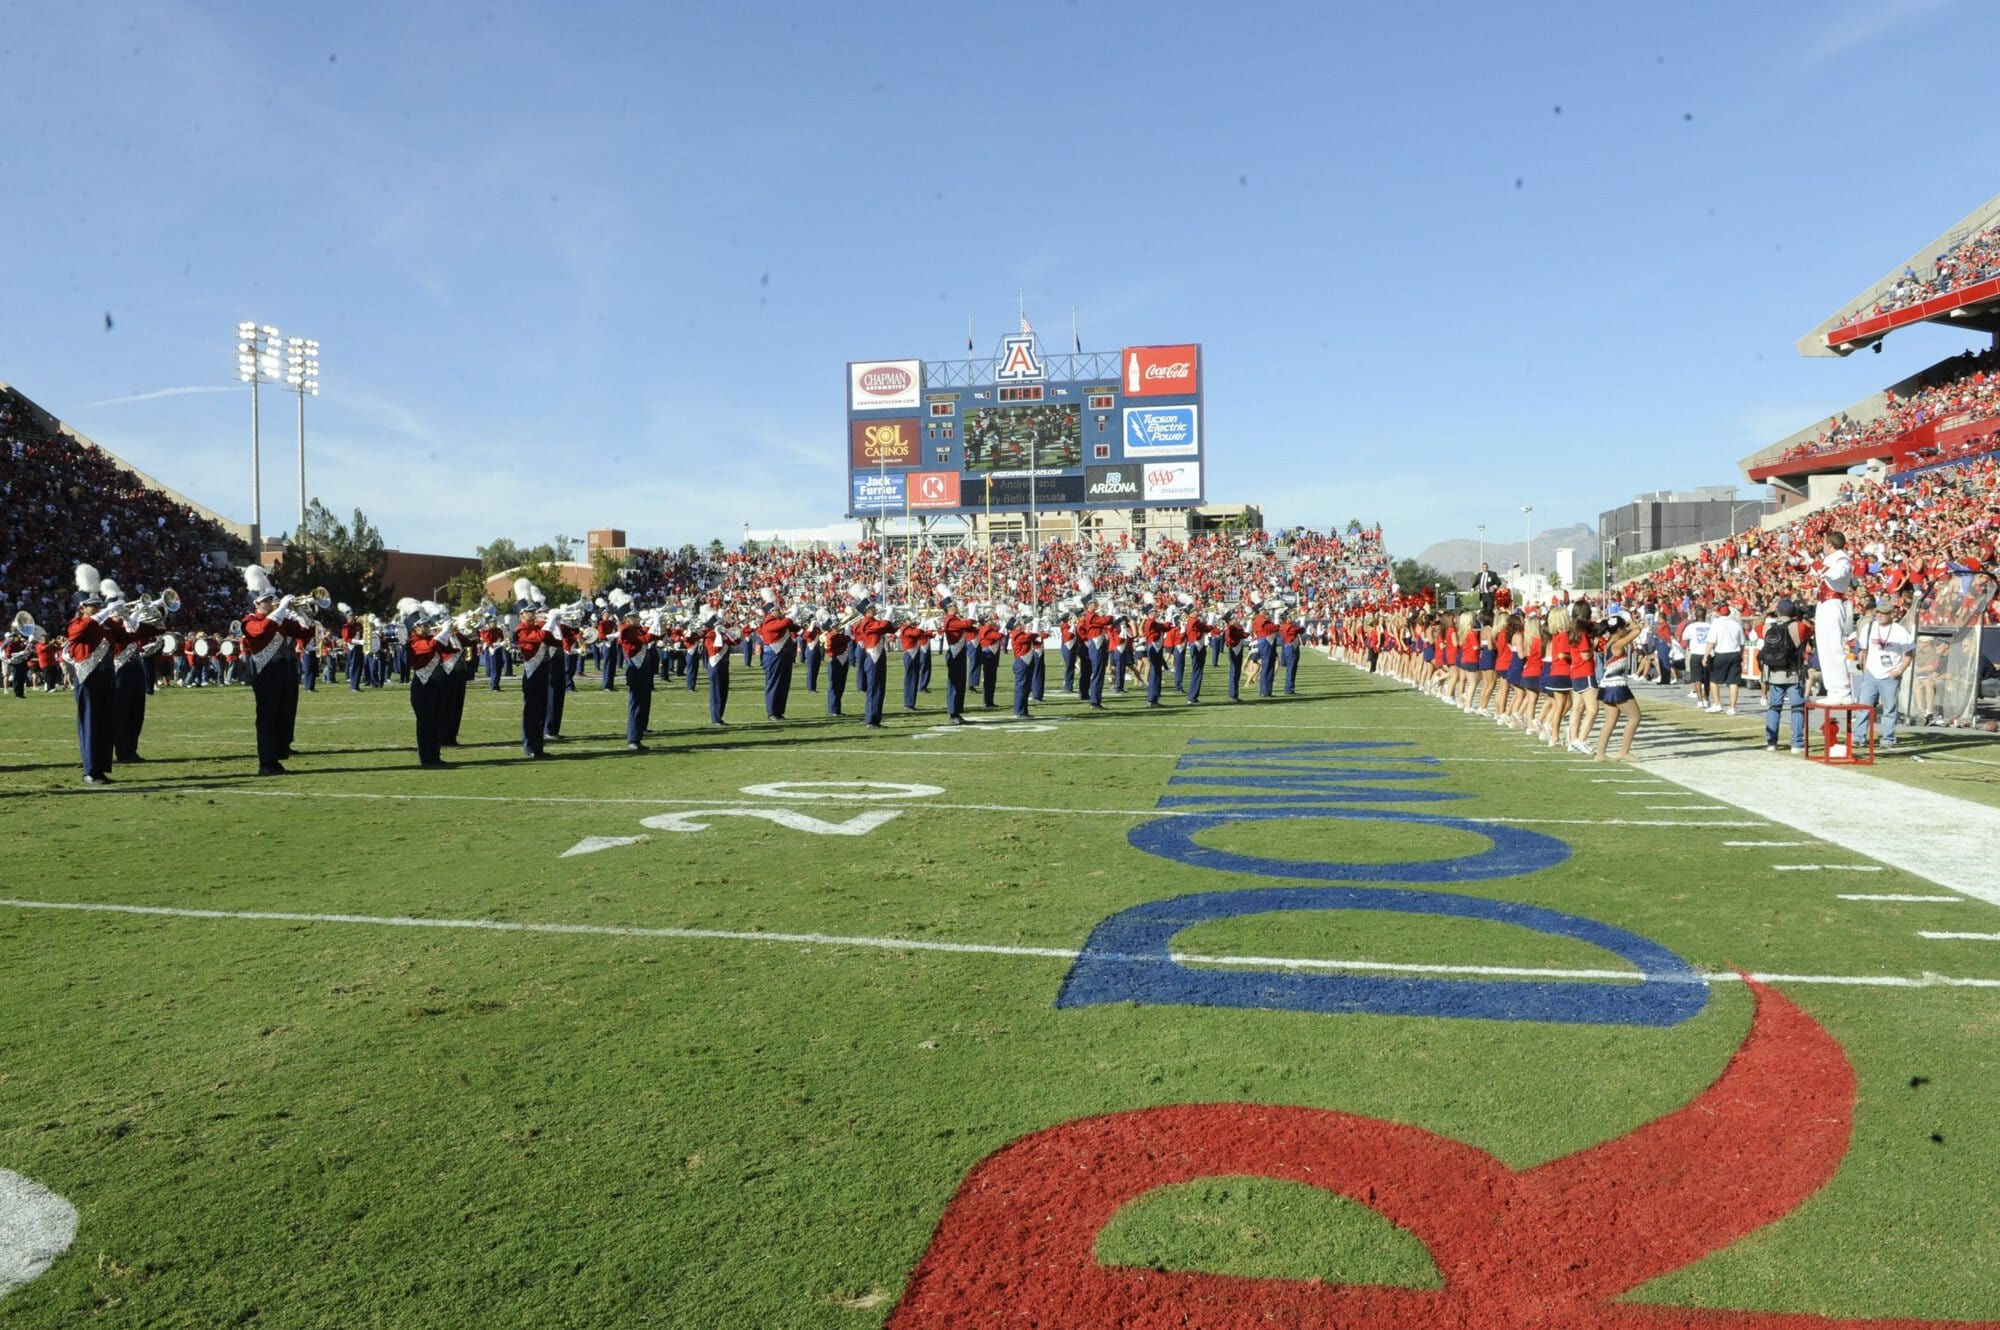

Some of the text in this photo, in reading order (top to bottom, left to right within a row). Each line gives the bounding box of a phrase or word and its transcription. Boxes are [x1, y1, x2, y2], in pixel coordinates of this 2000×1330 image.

[997, 337, 1044, 380] A
[864, 372, 906, 386] CHAPMAN
[1143, 414, 1178, 424] Tucson
[1147, 422, 1187, 432] Electric
[865, 424, 908, 447] SOL
[1151, 432, 1187, 442] Power
[866, 476, 891, 486] Jack
[1149, 470, 1173, 486] AAA
[1089, 482, 1136, 494] ARIZONA
[978, 495, 1000, 505] Mry
